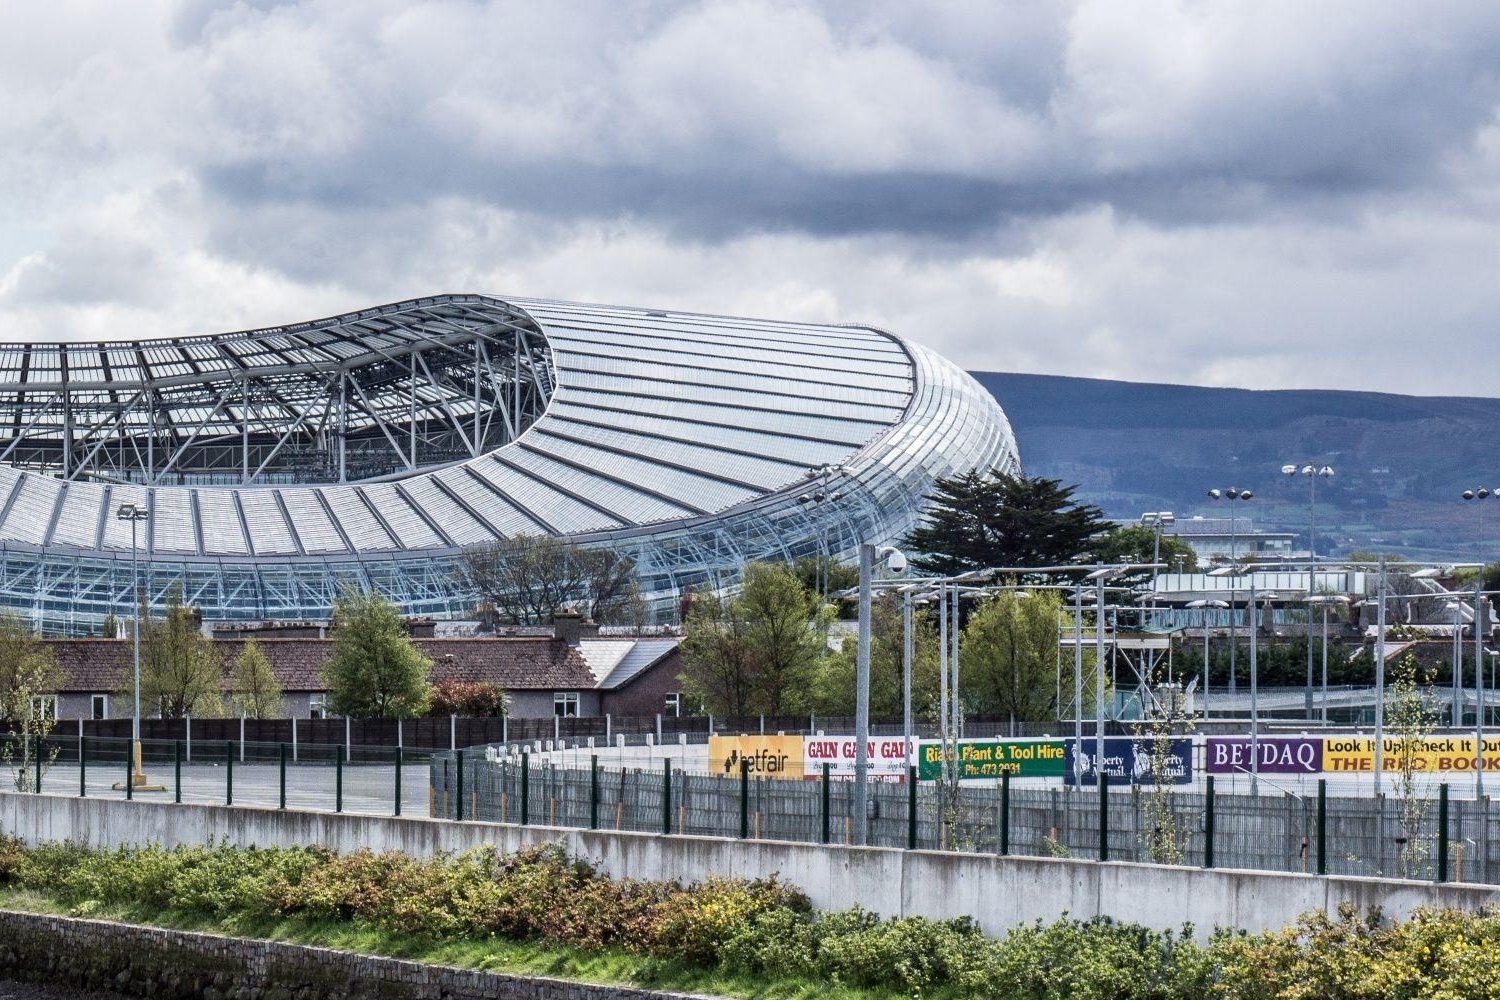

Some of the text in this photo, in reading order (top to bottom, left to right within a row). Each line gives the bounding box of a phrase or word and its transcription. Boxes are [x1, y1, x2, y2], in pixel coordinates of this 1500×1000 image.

[808, 742, 838, 758] GAIN
[842, 742, 875, 758] GAN
[926, 747, 960, 762] Riat
[995, 745, 1005, 760] &
[1008, 744, 1034, 759] Tool
[1037, 744, 1064, 759] Hire
[1327, 739, 1361, 753] Look
[1367, 740, 1376, 752] It
[1461, 740, 1471, 752] It
[1092, 754, 1124, 766] Lberty
[1151, 754, 1184, 765] Lerty
[1214, 743, 1316, 771] BETDAQ
[1331, 757, 1371, 770] THE
[1438, 757, 1500, 771] BOOK
[980, 763, 997, 775] 473
